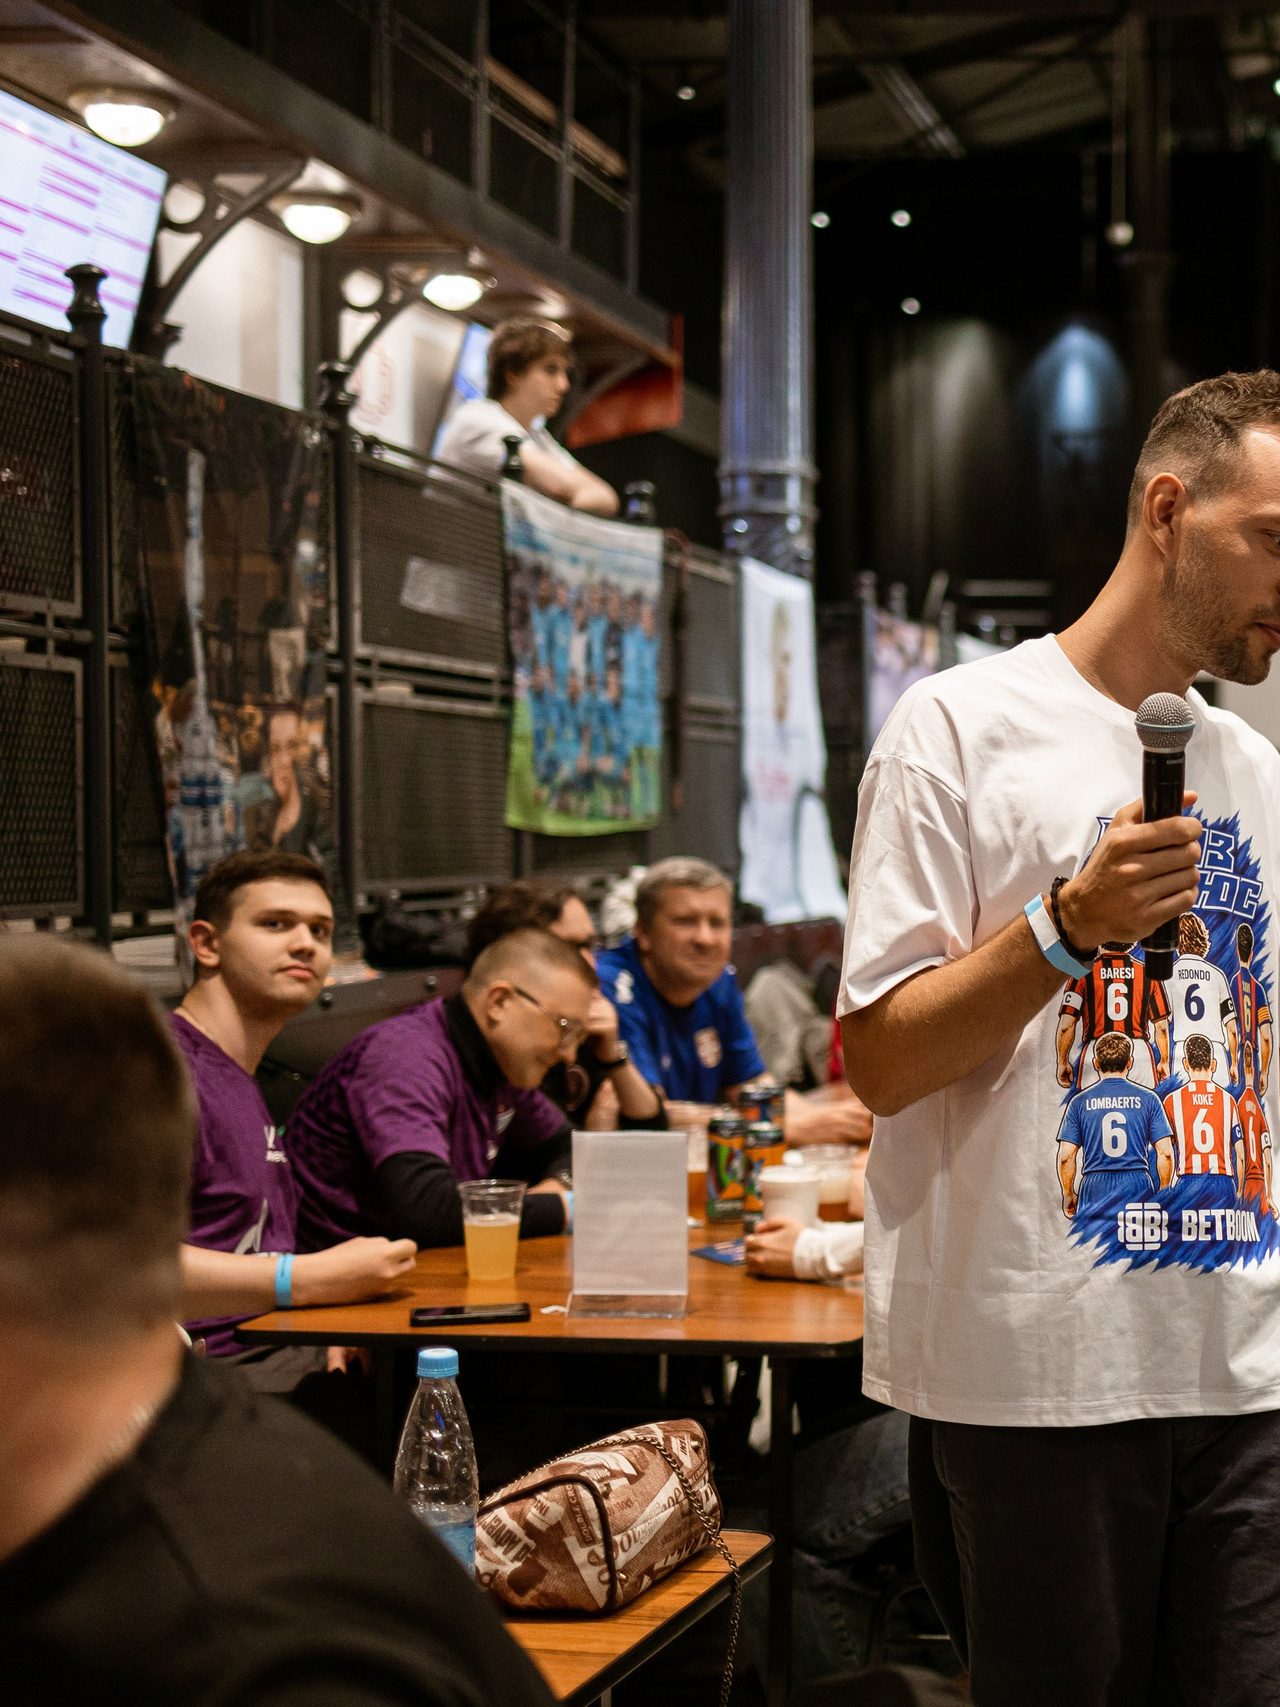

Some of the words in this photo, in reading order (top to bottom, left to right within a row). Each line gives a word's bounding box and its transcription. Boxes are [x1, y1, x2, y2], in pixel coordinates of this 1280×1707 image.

[1100, 967, 1135, 980] BARESI
[1178, 969, 1211, 982] REDONDO
[1106, 982, 1129, 1022] 6
[1184, 983, 1206, 1022] 6
[1243, 994, 1252, 1033] 6
[1086, 1096, 1142, 1111] LOMBAERTS
[1192, 1094, 1214, 1106] KOKE
[1102, 1111, 1128, 1158] 6
[1192, 1108, 1215, 1154] 6
[1248, 1115, 1257, 1163] 6
[1181, 1208, 1261, 1242] BETBOOM
